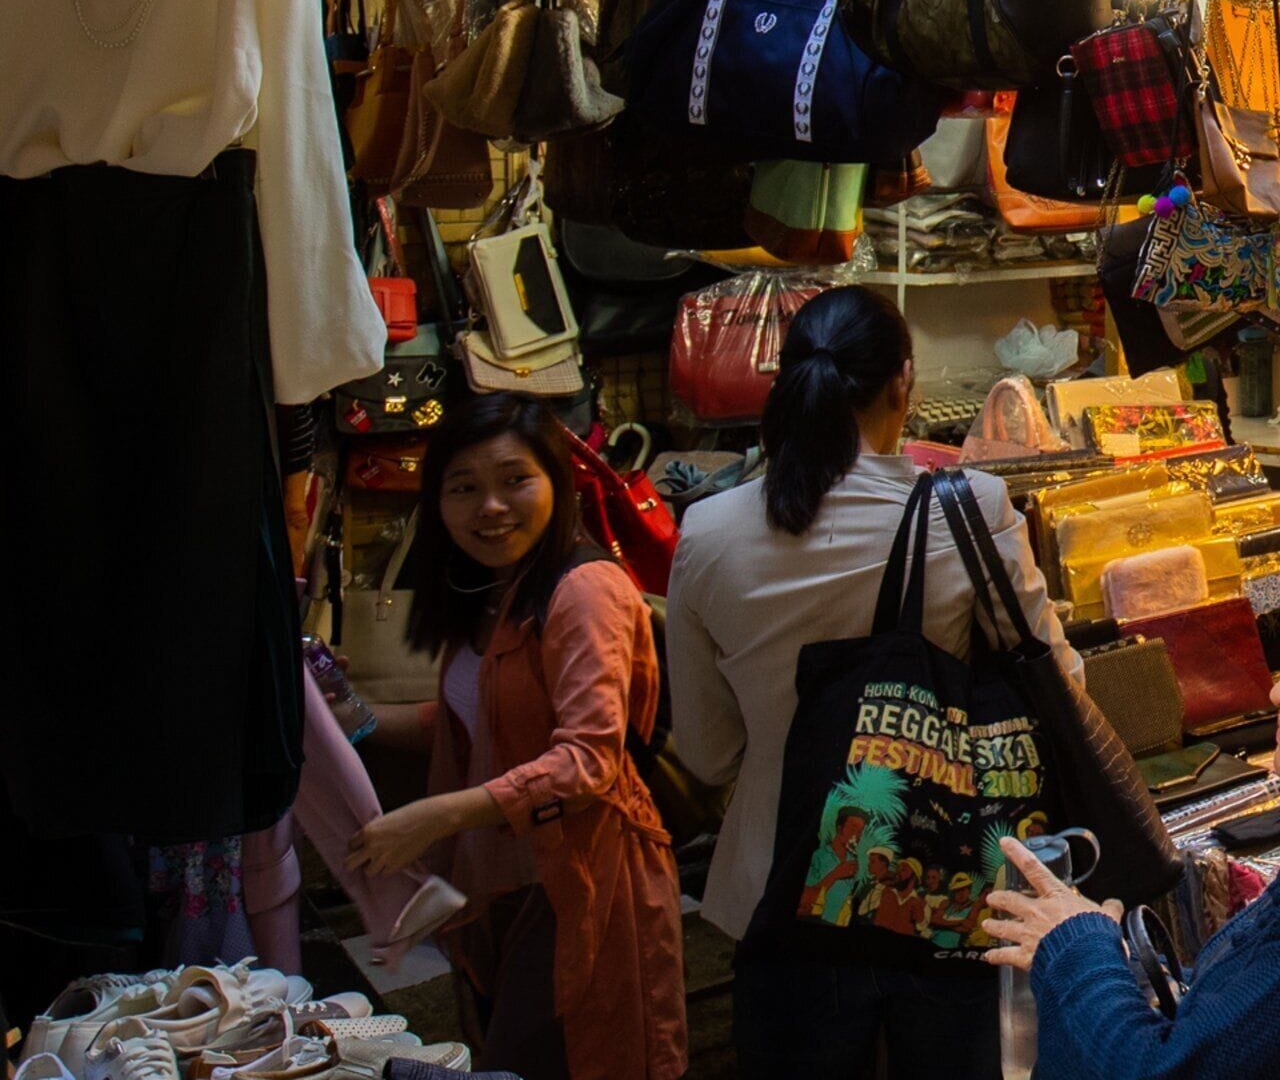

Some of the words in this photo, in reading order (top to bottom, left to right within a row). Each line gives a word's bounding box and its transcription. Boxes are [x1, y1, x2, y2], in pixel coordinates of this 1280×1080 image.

[864, 683, 902, 698] HONG
[908, 685, 940, 711] KON
[847, 734, 978, 798] FESTIVAL
[982, 770, 1038, 798] 2018
[855, 703, 973, 763] REGGAE
[974, 732, 1040, 770] SKA
